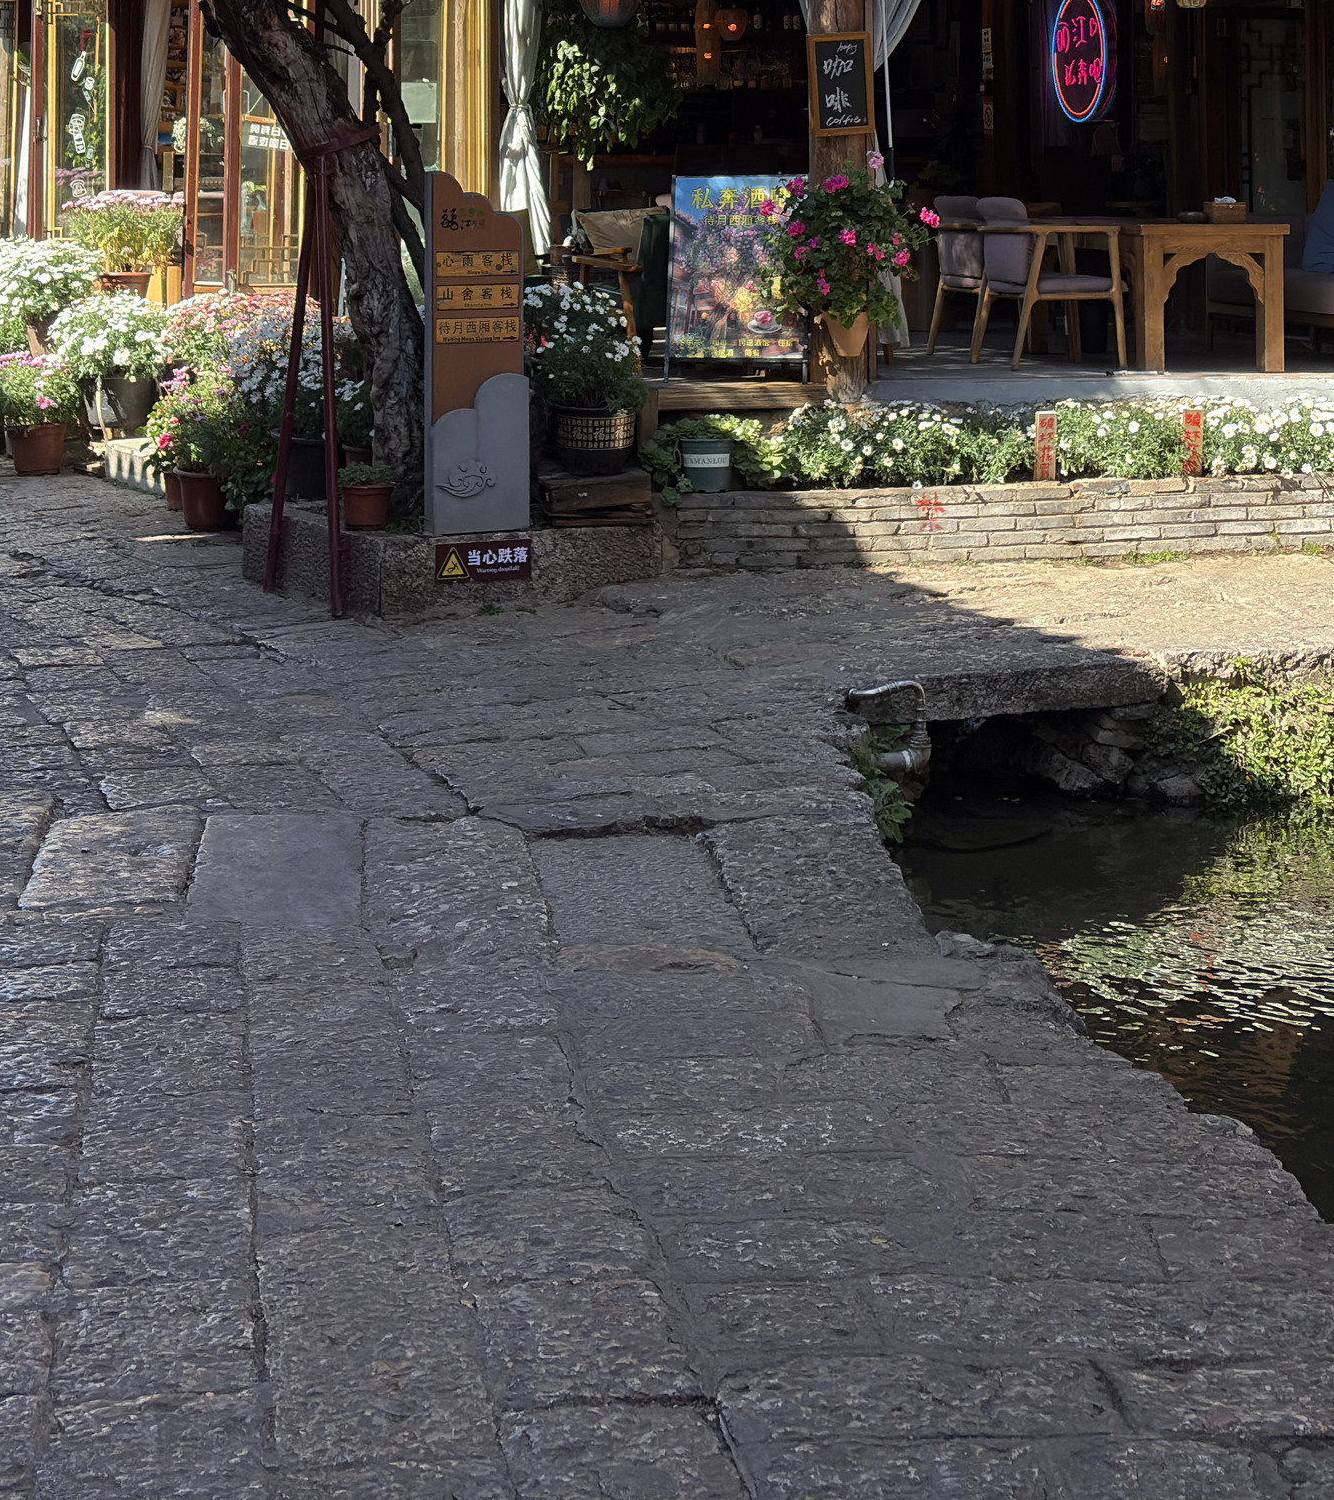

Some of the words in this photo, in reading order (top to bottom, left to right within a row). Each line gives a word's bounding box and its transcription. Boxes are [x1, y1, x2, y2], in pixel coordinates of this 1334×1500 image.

[823, 54, 854, 113] 咖啡
[442, 253, 513, 268] 心雨客栈
[442, 287, 513, 301] 山舍客栈
[438, 319, 517, 335] 待月西厢客栈
[468, 547, 528, 566] 当心跌落
